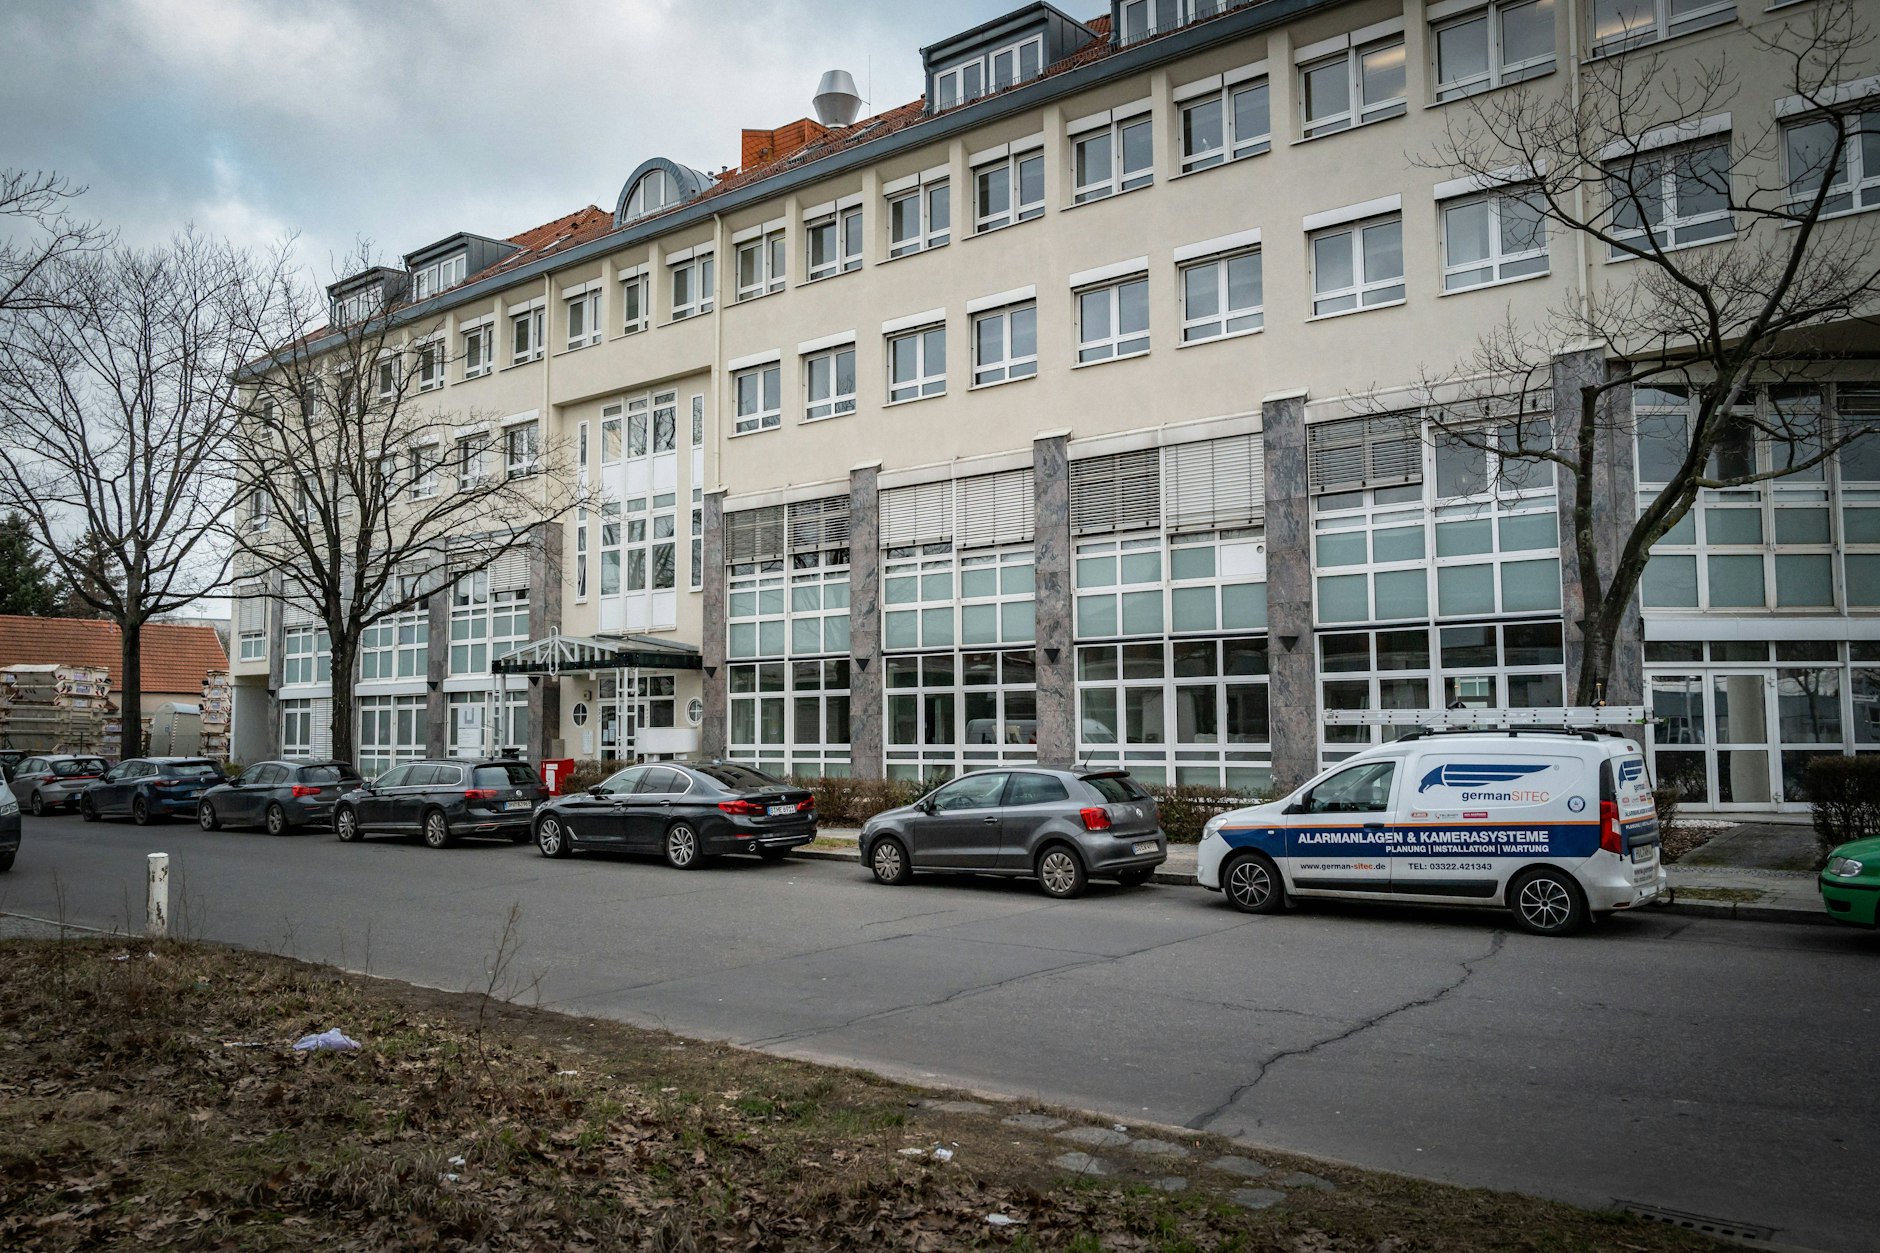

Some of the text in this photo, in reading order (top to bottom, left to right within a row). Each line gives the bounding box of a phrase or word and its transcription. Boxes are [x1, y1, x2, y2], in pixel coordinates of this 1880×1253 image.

[1461, 790, 1550, 802] germanSITEC
[1298, 830, 1550, 843] ALARMANLAGEN & KAMERASYSTEME
[1386, 845, 1427, 853] PLANUNG
[1433, 845, 1495, 853] INSTALLATION
[1502, 844, 1550, 853] WARTUNG
